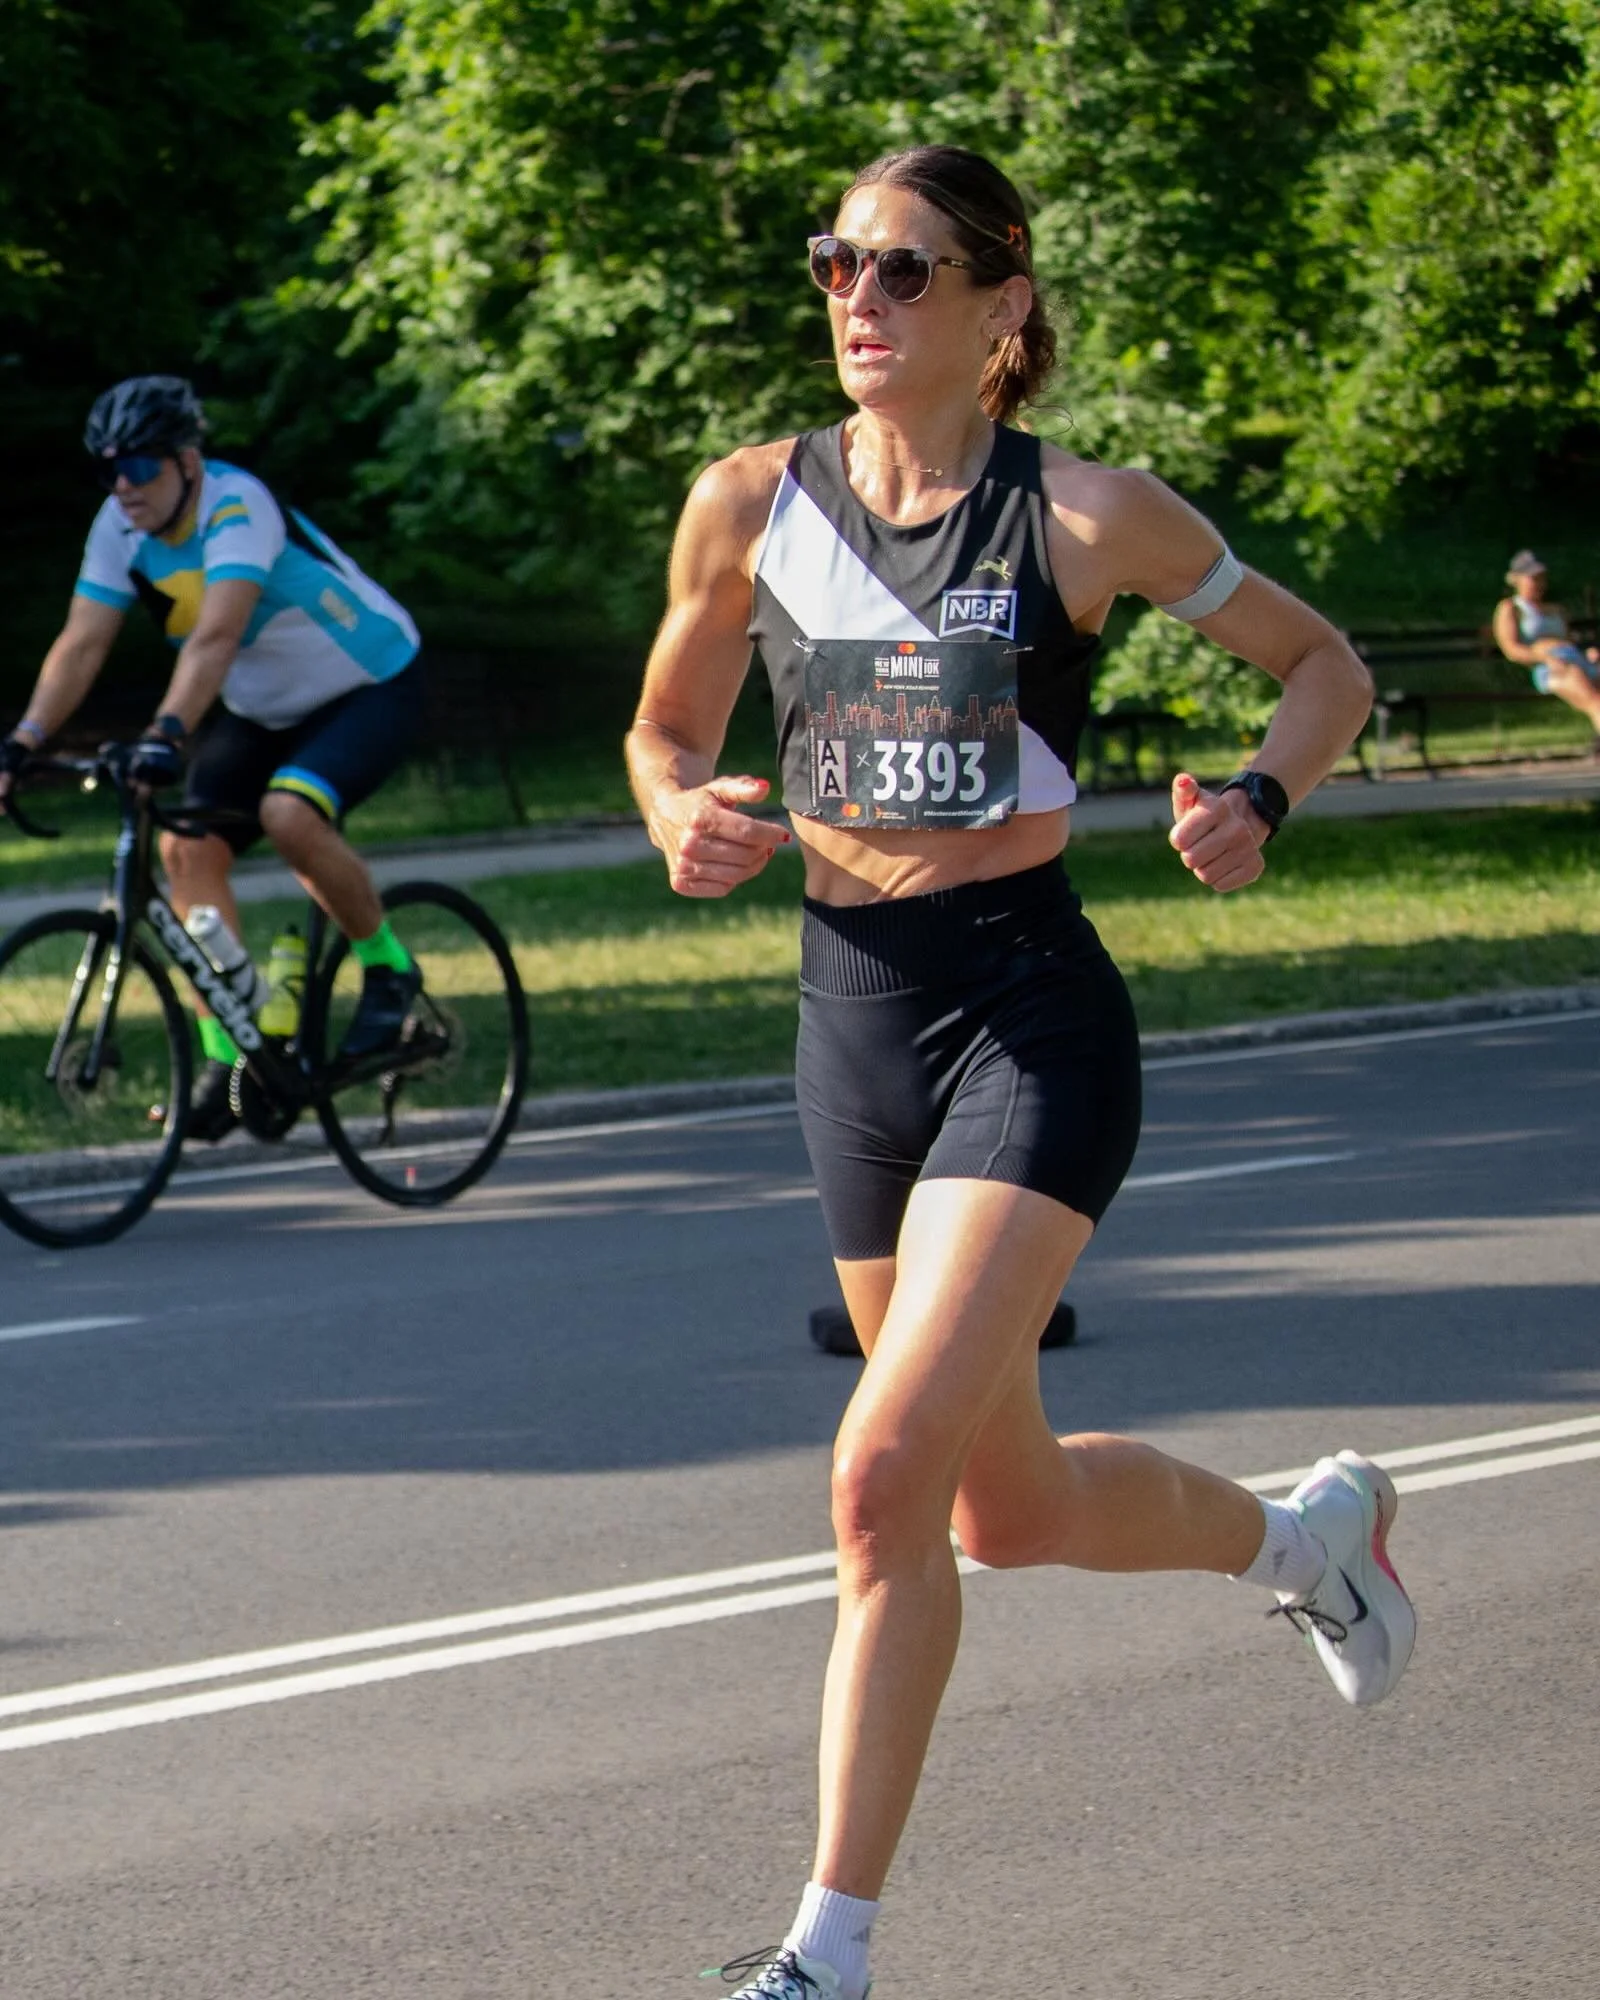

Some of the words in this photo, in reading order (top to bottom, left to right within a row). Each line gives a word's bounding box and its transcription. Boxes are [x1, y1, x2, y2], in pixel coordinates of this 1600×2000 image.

[949, 599, 1008, 619] NBR
[890, 656, 922, 679] MINI
[821, 740, 838, 766] A
[824, 769, 841, 795] A
[873, 741, 985, 802] 3393
